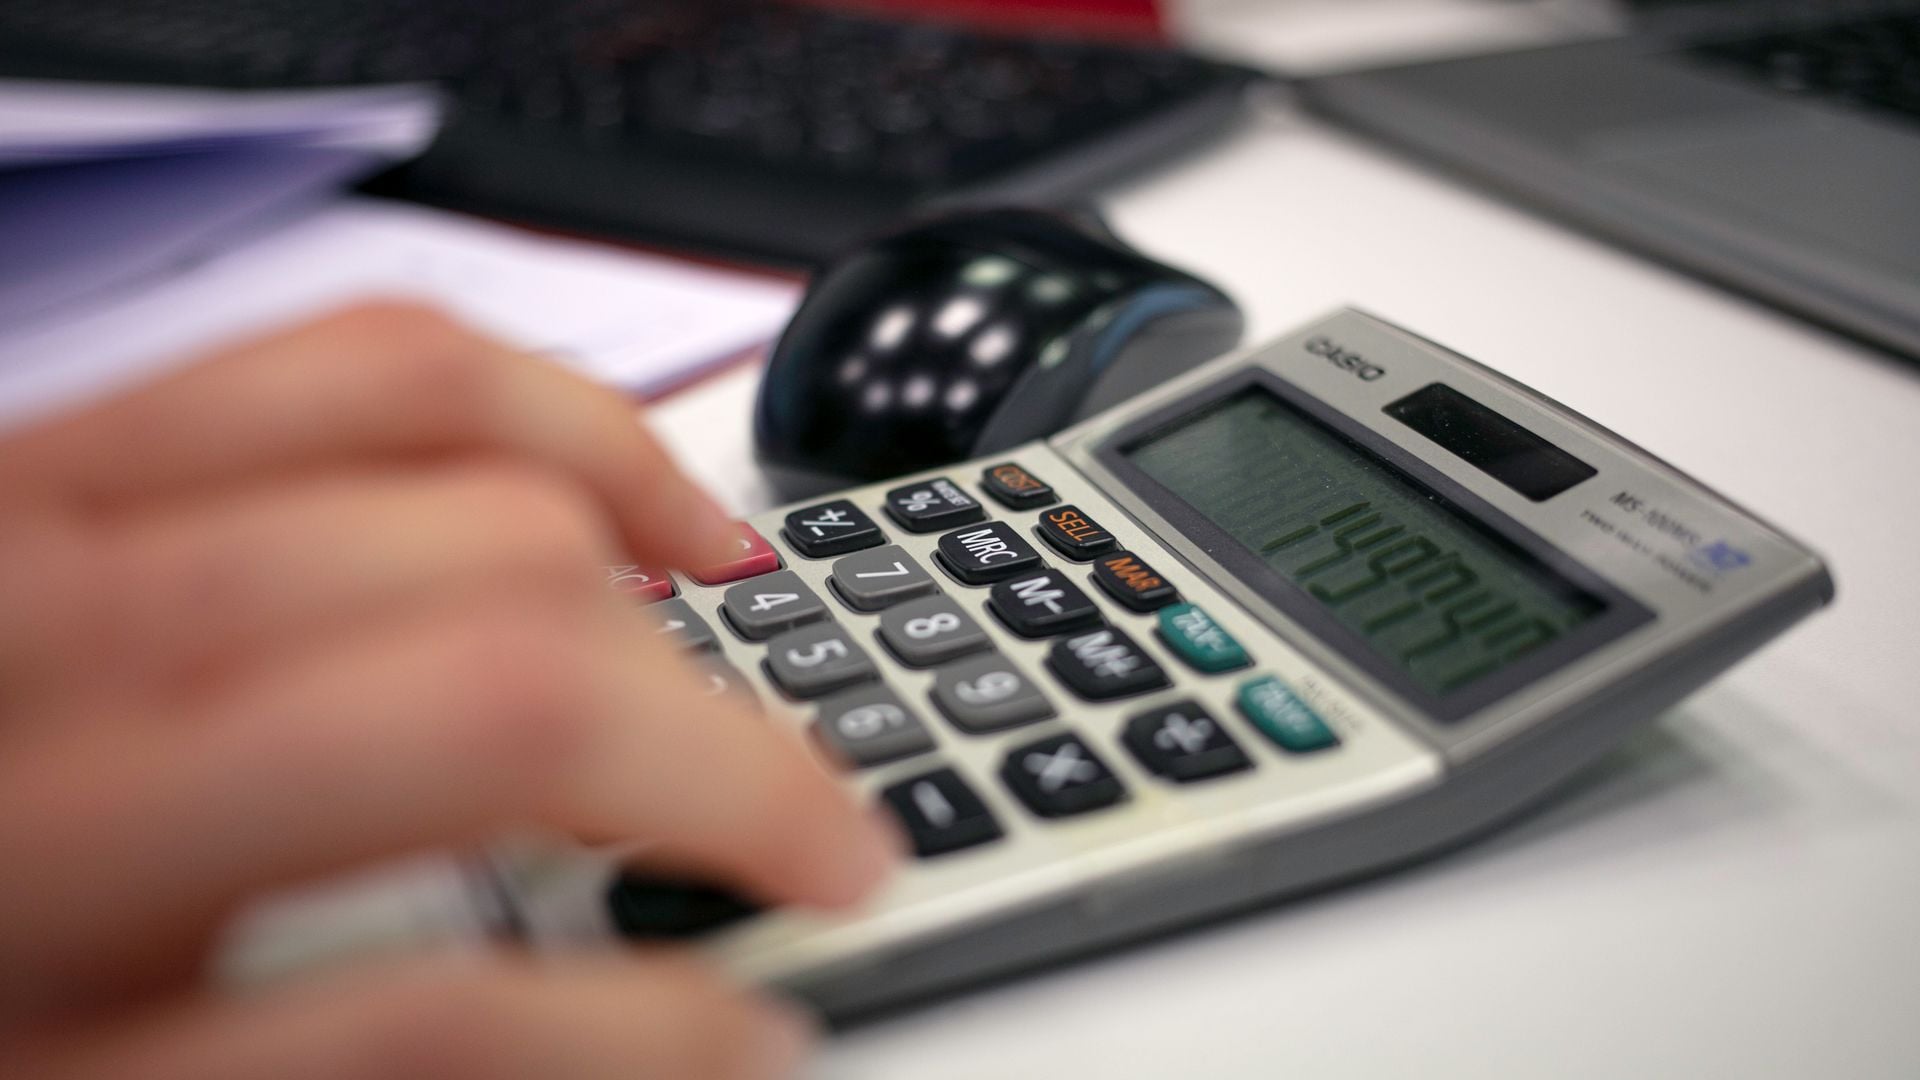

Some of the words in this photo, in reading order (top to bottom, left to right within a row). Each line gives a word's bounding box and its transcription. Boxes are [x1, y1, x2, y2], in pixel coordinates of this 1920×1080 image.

[1304, 337, 1385, 382] CASIO
[993, 465, 1042, 491] COST
[899, 491, 941, 512] %
[1050, 511, 1099, 542] SELL
[957, 529, 1018, 564] MRC
[856, 562, 910, 578] 7
[1104, 556, 1161, 592] MAR
[750, 593, 800, 612] 4
[1010, 576, 1065, 614] M-
[904, 613, 961, 639] 8
[787, 639, 849, 668] 5
[955, 671, 1021, 704] 9
[837, 703, 906, 740] 6
